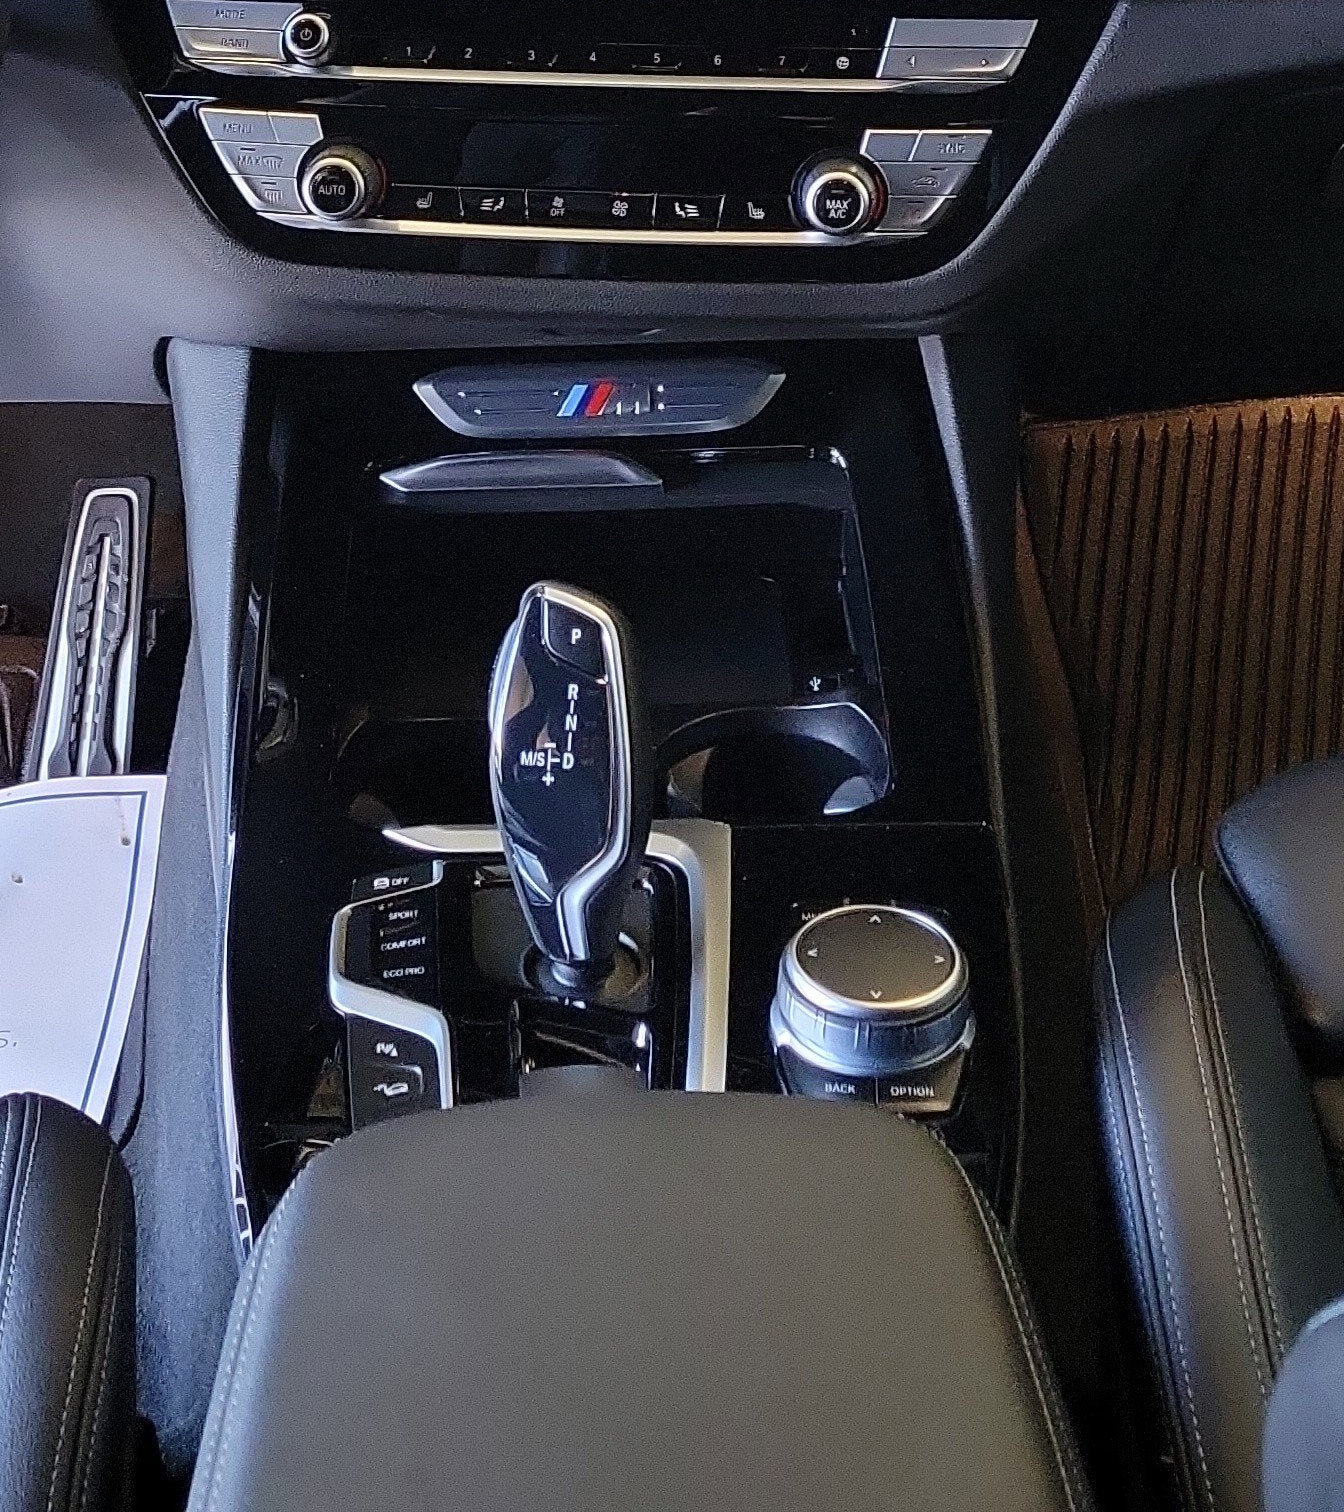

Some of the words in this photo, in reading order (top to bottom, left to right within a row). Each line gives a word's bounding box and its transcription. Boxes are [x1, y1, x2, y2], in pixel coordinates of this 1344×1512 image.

[463, 47, 473, 59] 2
[527, 49, 536, 61] 3
[588, 51, 597, 62] 4
[652, 52, 661, 64] 5
[713, 54, 722, 66] 6
[778, 55, 786, 66] 7
[223, 122, 252, 134] MENU
[317, 184, 346, 196] AUTO
[825, 199, 849, 210] MAX
[550, 207, 565, 217] OFF
[828, 209, 847, 219] A/C
[570, 628, 582, 646] P
[567, 683, 579, 700] R
[565, 714, 578, 732] N
[520, 750, 546, 767] M/S
[561, 752, 575, 770] D
[388, 909, 419, 921] SPORT
[889, 1085, 935, 1098] OPTION
